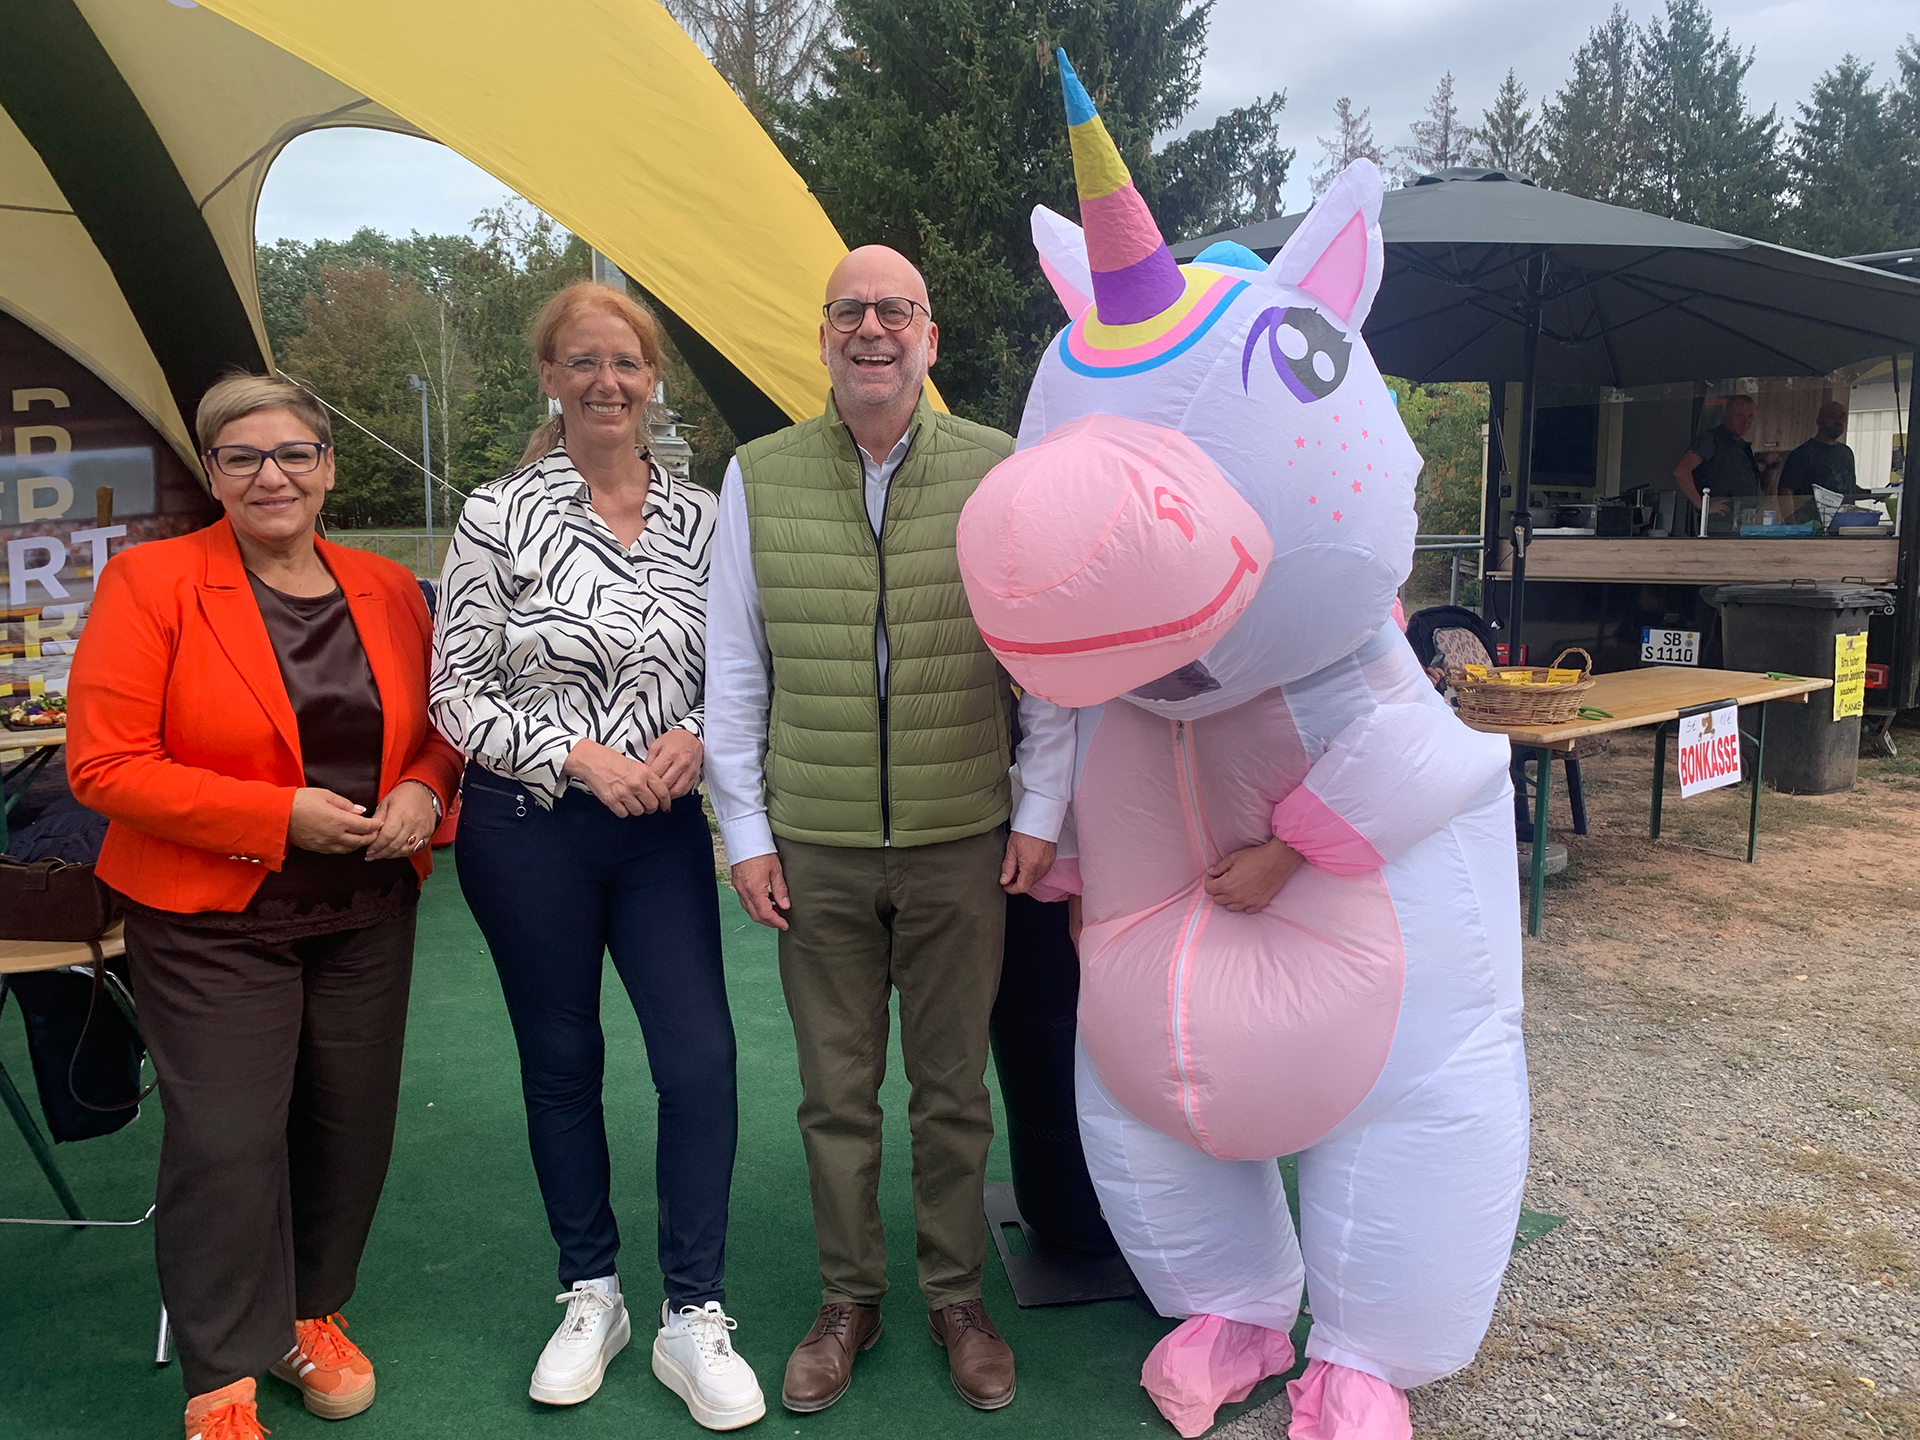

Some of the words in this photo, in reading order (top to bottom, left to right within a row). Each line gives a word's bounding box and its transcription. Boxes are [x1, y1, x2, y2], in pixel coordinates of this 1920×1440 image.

[1663, 632, 1682, 646] SB
[1644, 646, 1654, 660] S
[1656, 647, 1693, 662] 1110
[1681, 734, 1738, 786] BONKASSE
